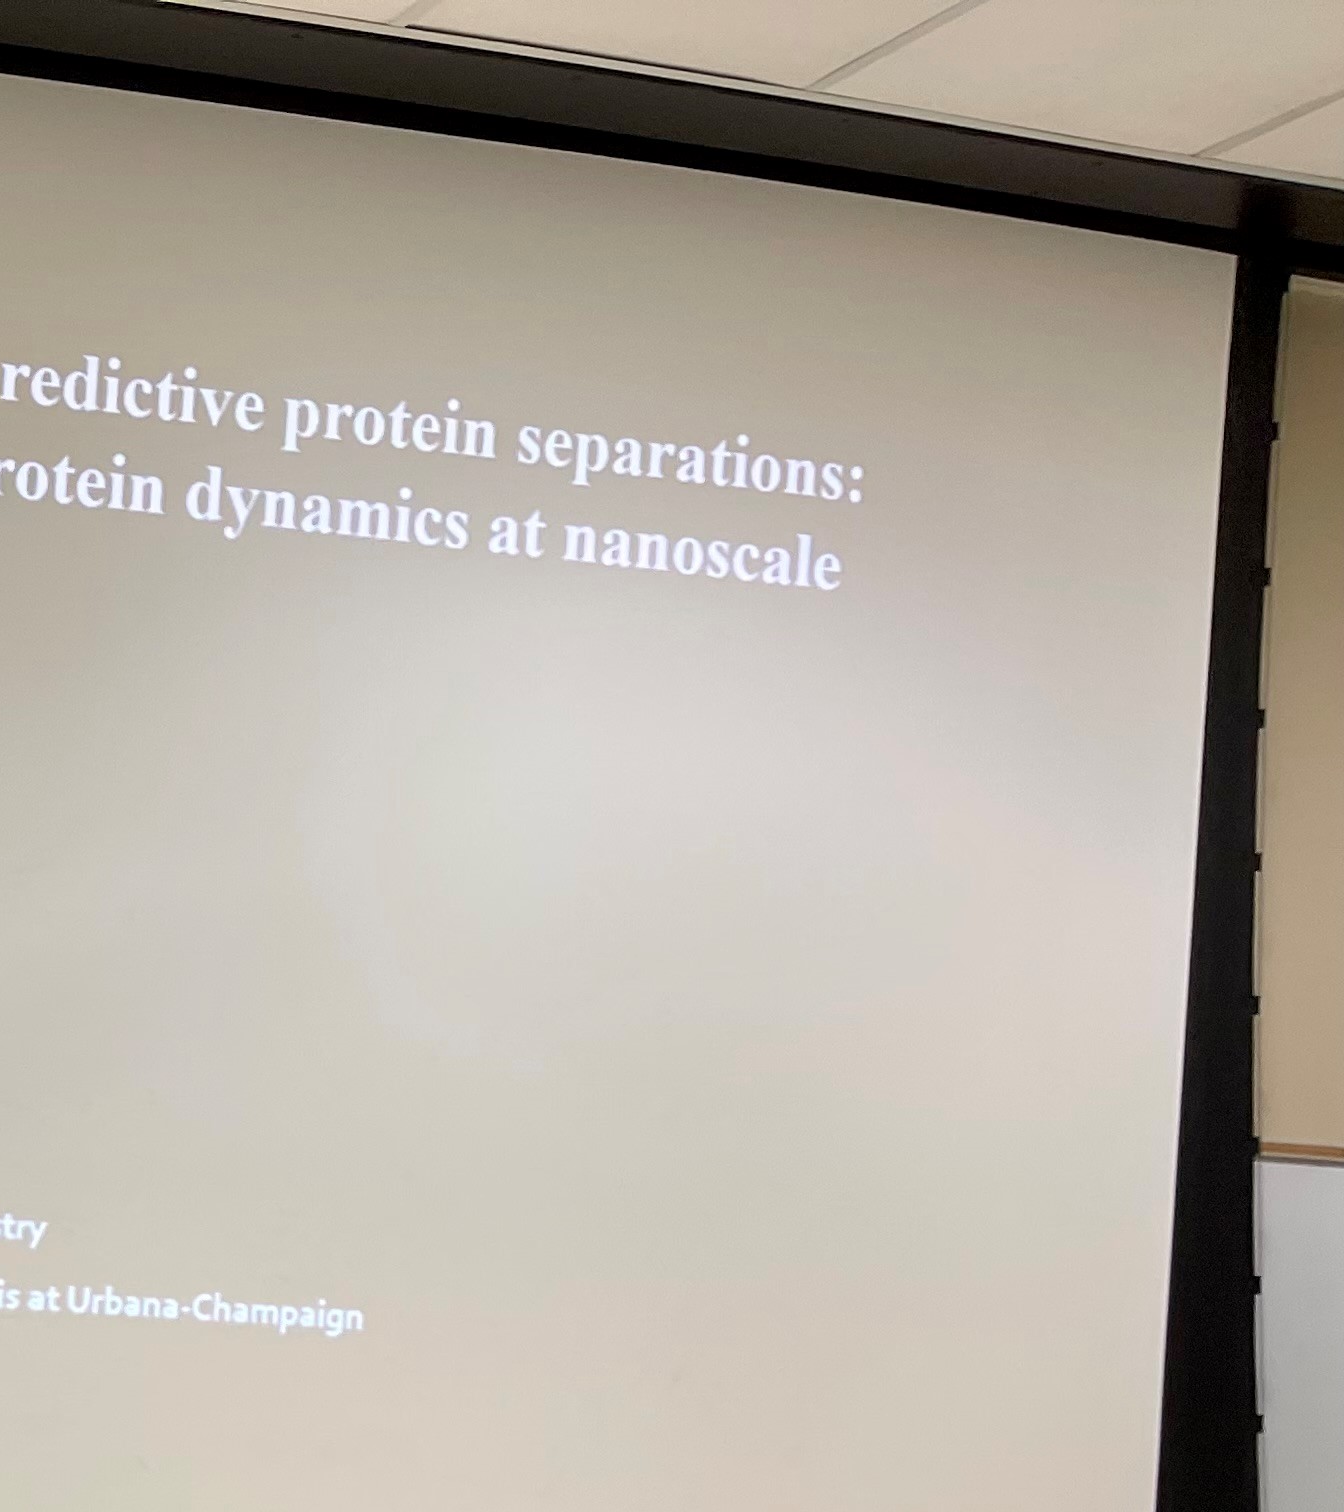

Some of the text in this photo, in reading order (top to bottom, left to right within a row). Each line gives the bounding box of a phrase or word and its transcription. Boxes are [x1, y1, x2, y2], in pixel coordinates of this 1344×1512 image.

[281, 398, 497, 458] protein
[517, 425, 864, 503] separations:
[185, 465, 469, 549] dynamics
[488, 510, 547, 558] at
[562, 525, 842, 591] nanoscale
[27, 1284, 61, 1313] at
[66, 1284, 365, 1338] Urbana-Champaign
